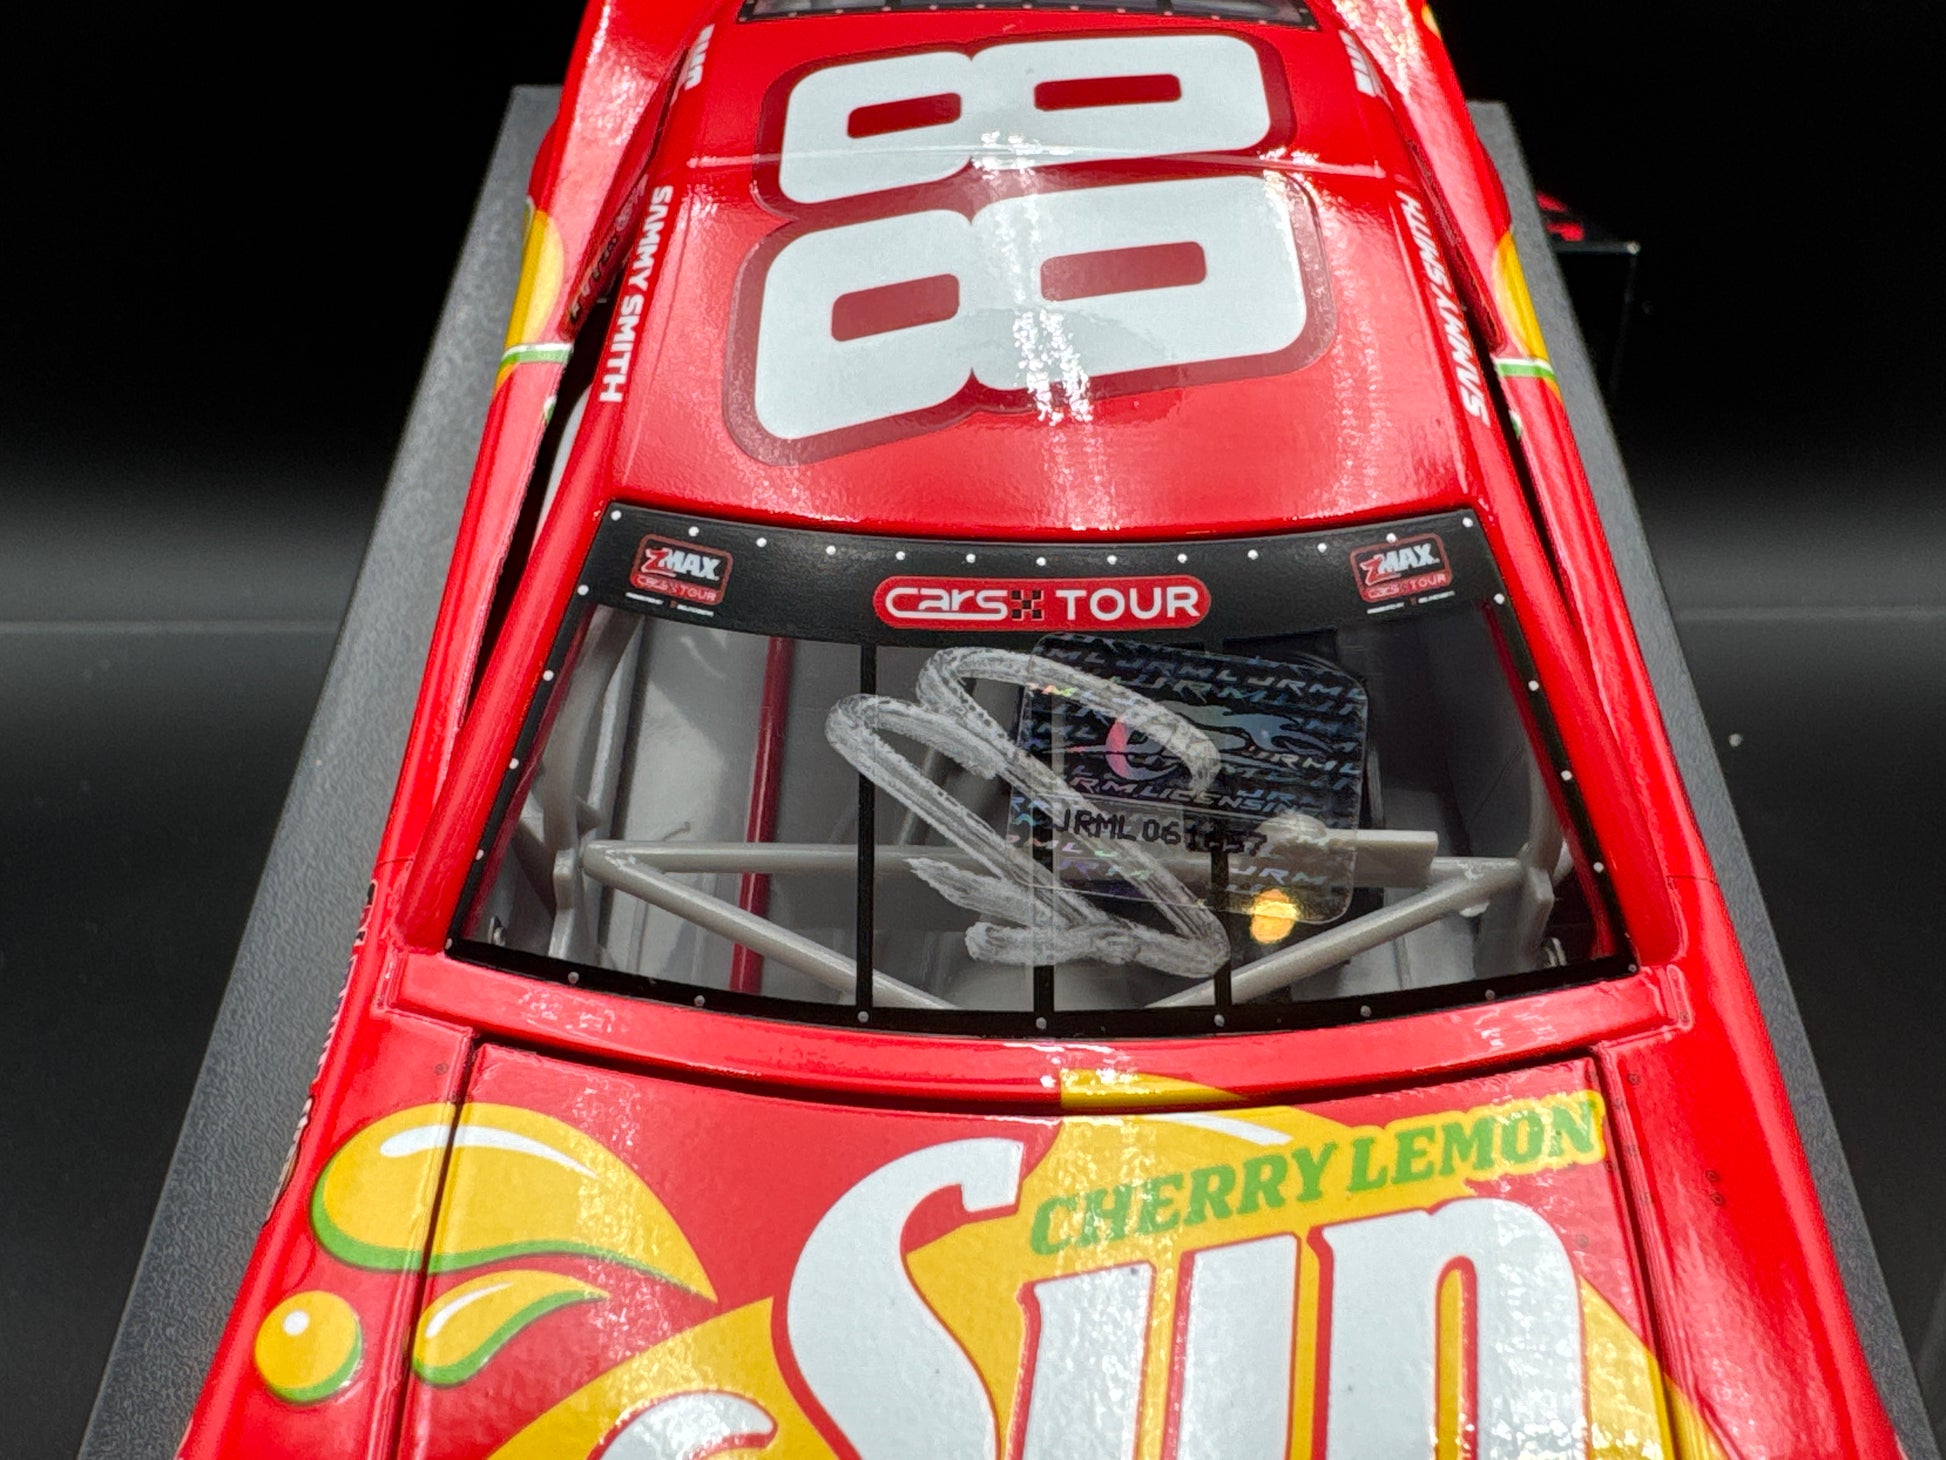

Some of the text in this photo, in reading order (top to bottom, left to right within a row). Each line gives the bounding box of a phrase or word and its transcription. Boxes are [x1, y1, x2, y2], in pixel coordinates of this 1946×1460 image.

[628, 184, 674, 292] SAMMY
[600, 294, 645, 403] SMITH
[1395, 190, 1491, 427] SAMMY SMITH
[1055, 586, 1201, 621] TOUR
[1053, 808, 1137, 842] JRML
[1029, 1098, 1602, 1257] CHERRY LEMON
